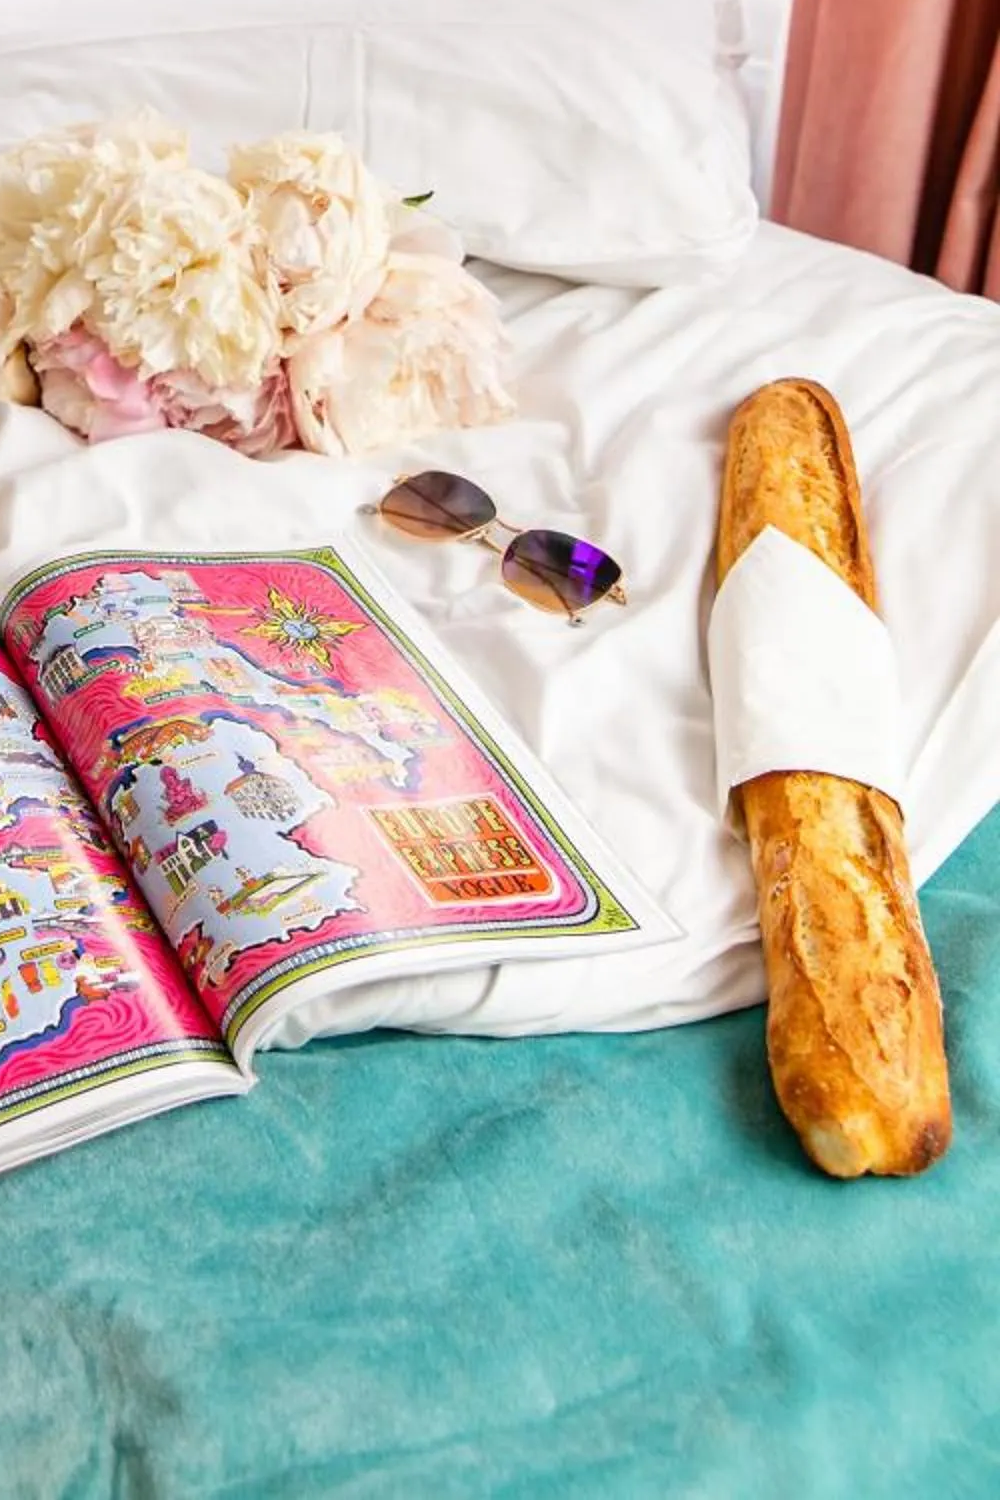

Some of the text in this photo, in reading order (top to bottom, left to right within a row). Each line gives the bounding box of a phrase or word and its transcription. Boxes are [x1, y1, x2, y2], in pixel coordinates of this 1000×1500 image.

[370, 799, 508, 841] EUROPE
[400, 837, 533, 878] EXPRESS
[438, 873, 535, 899] VOGUE
